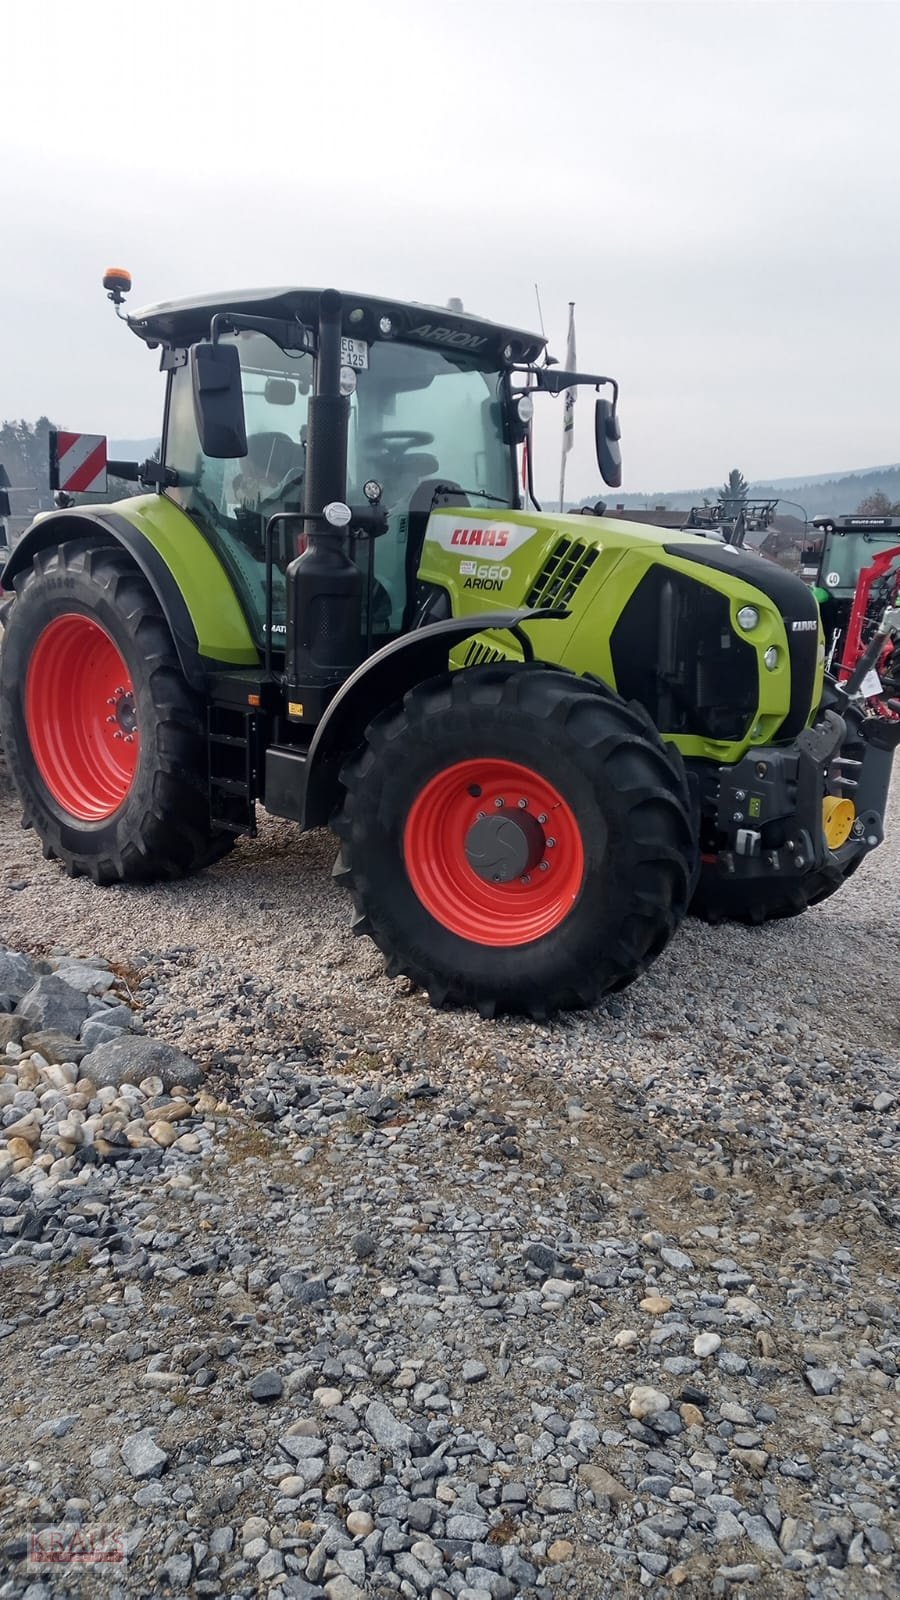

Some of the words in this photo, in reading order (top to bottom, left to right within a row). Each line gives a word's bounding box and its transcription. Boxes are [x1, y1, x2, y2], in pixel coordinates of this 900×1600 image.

[409, 324, 488, 347] ARION
[341, 338, 354, 352] EG
[346, 353, 365, 367] 125
[451, 529, 510, 547] CLAAS
[477, 565, 511, 580] 660
[829, 574, 837, 584] 40
[463, 578, 504, 591] ARION
